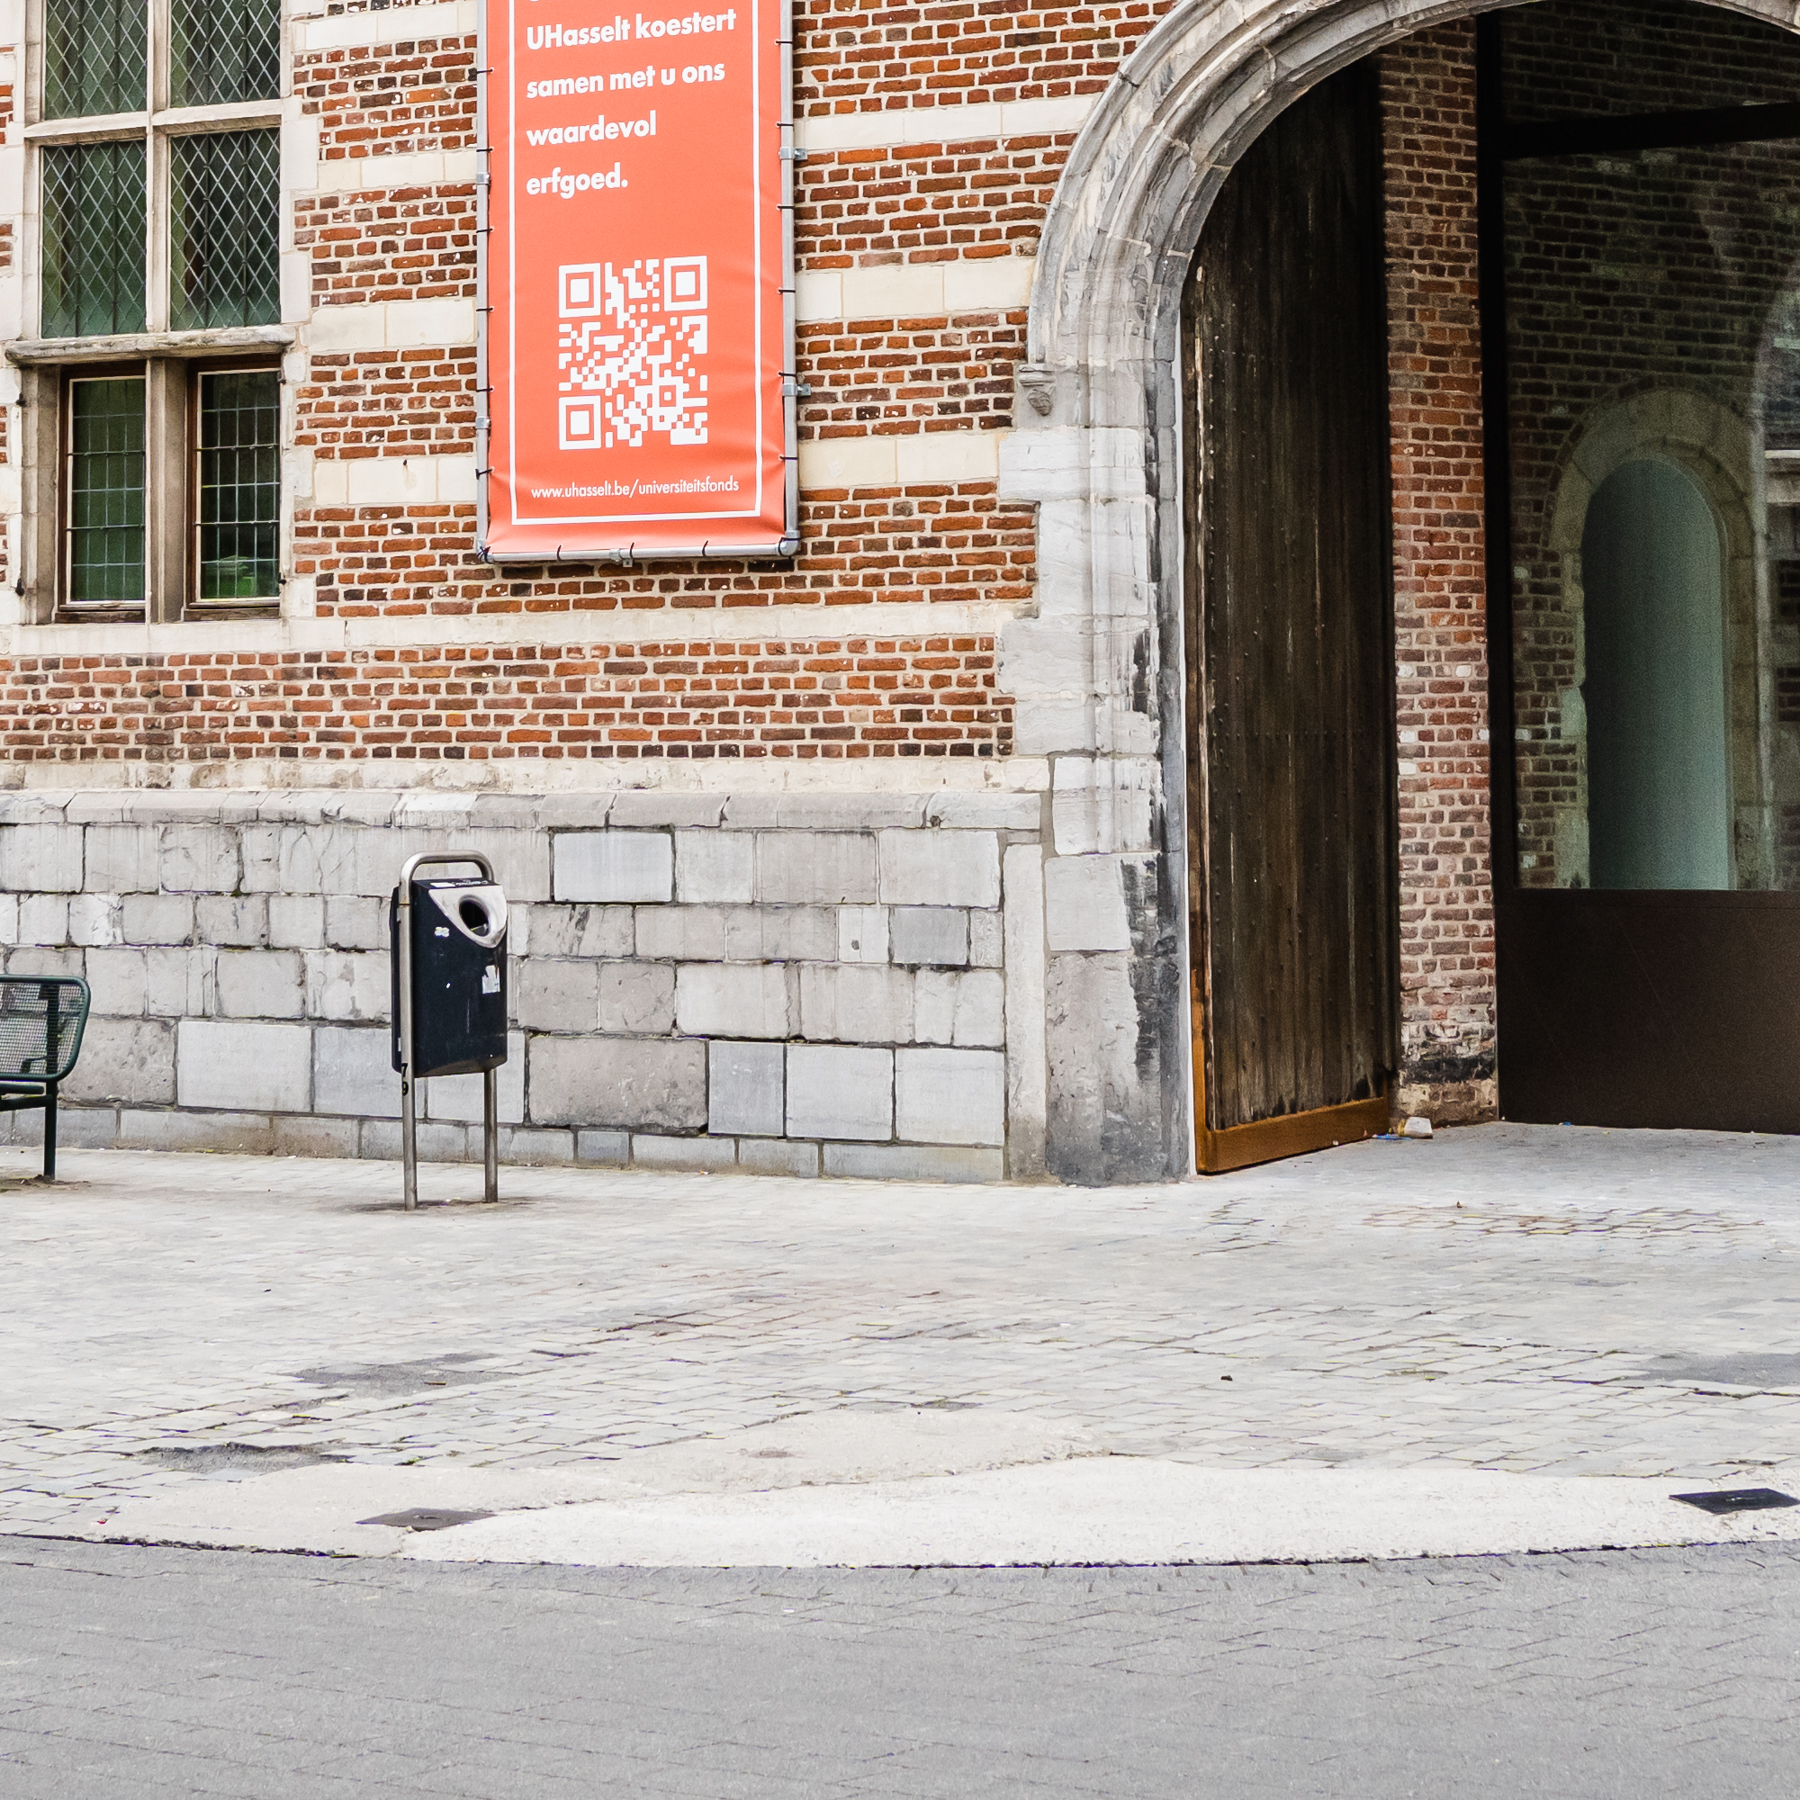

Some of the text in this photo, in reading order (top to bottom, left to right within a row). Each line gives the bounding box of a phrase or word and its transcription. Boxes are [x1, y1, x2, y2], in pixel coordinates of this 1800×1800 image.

[526, 8, 737, 50] UHasselt koestert
[526, 63, 726, 99] samen met u ons
[526, 109, 657, 147] waardevol
[526, 161, 629, 200] erfgoed.
[531, 474, 740, 499] www.uhasselt.be/universiteitsfonds
